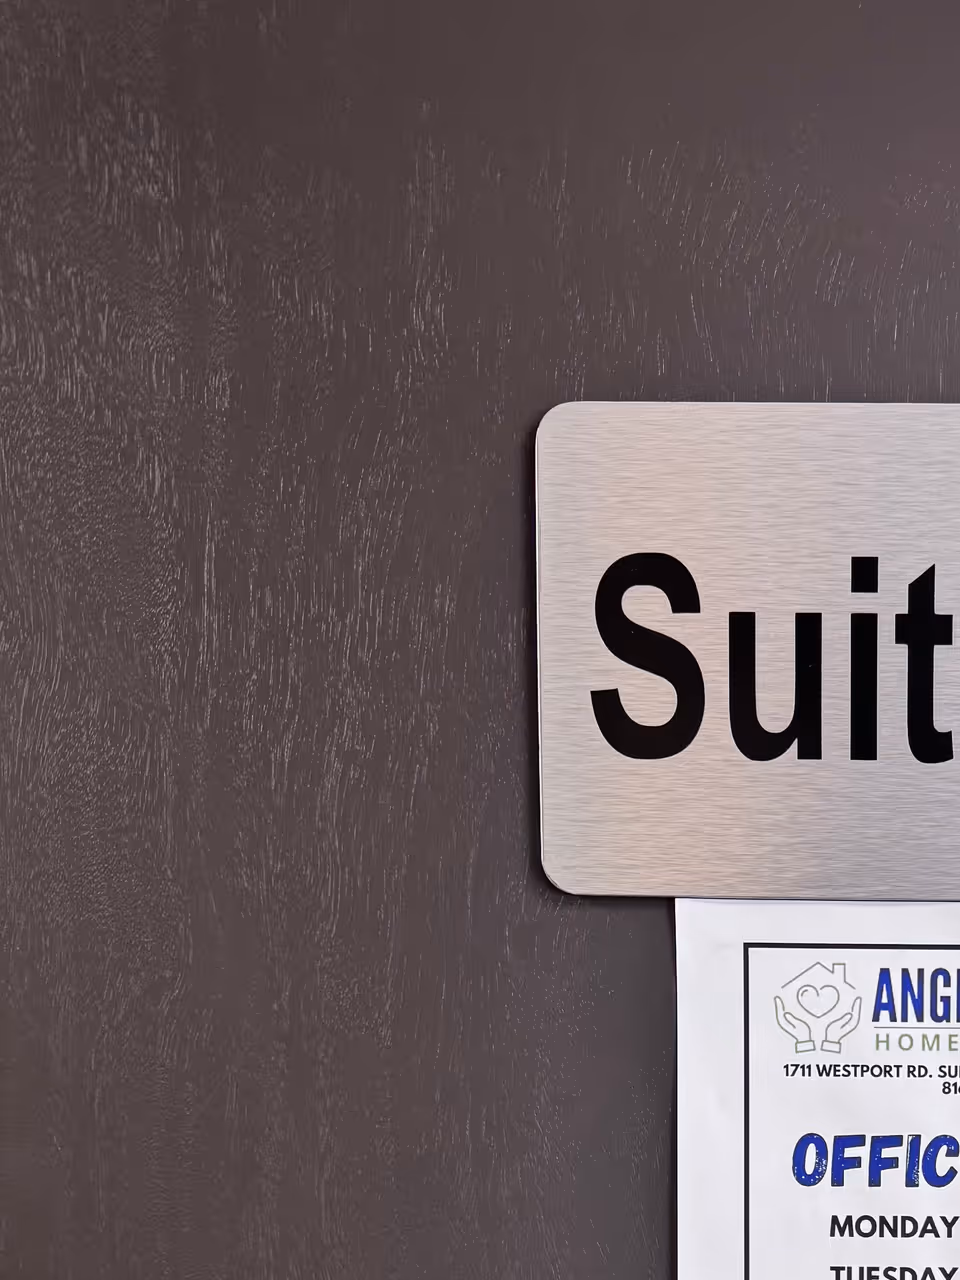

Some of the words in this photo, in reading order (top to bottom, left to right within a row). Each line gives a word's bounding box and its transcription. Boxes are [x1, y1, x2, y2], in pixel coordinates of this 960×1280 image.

[876, 1034, 958, 1051] HOME
[784, 1064, 811, 1077] 1711
[816, 1064, 902, 1077] WESTPORT
[907, 1065, 932, 1078] RD.
[830, 1215, 959, 1238] MONDAY
